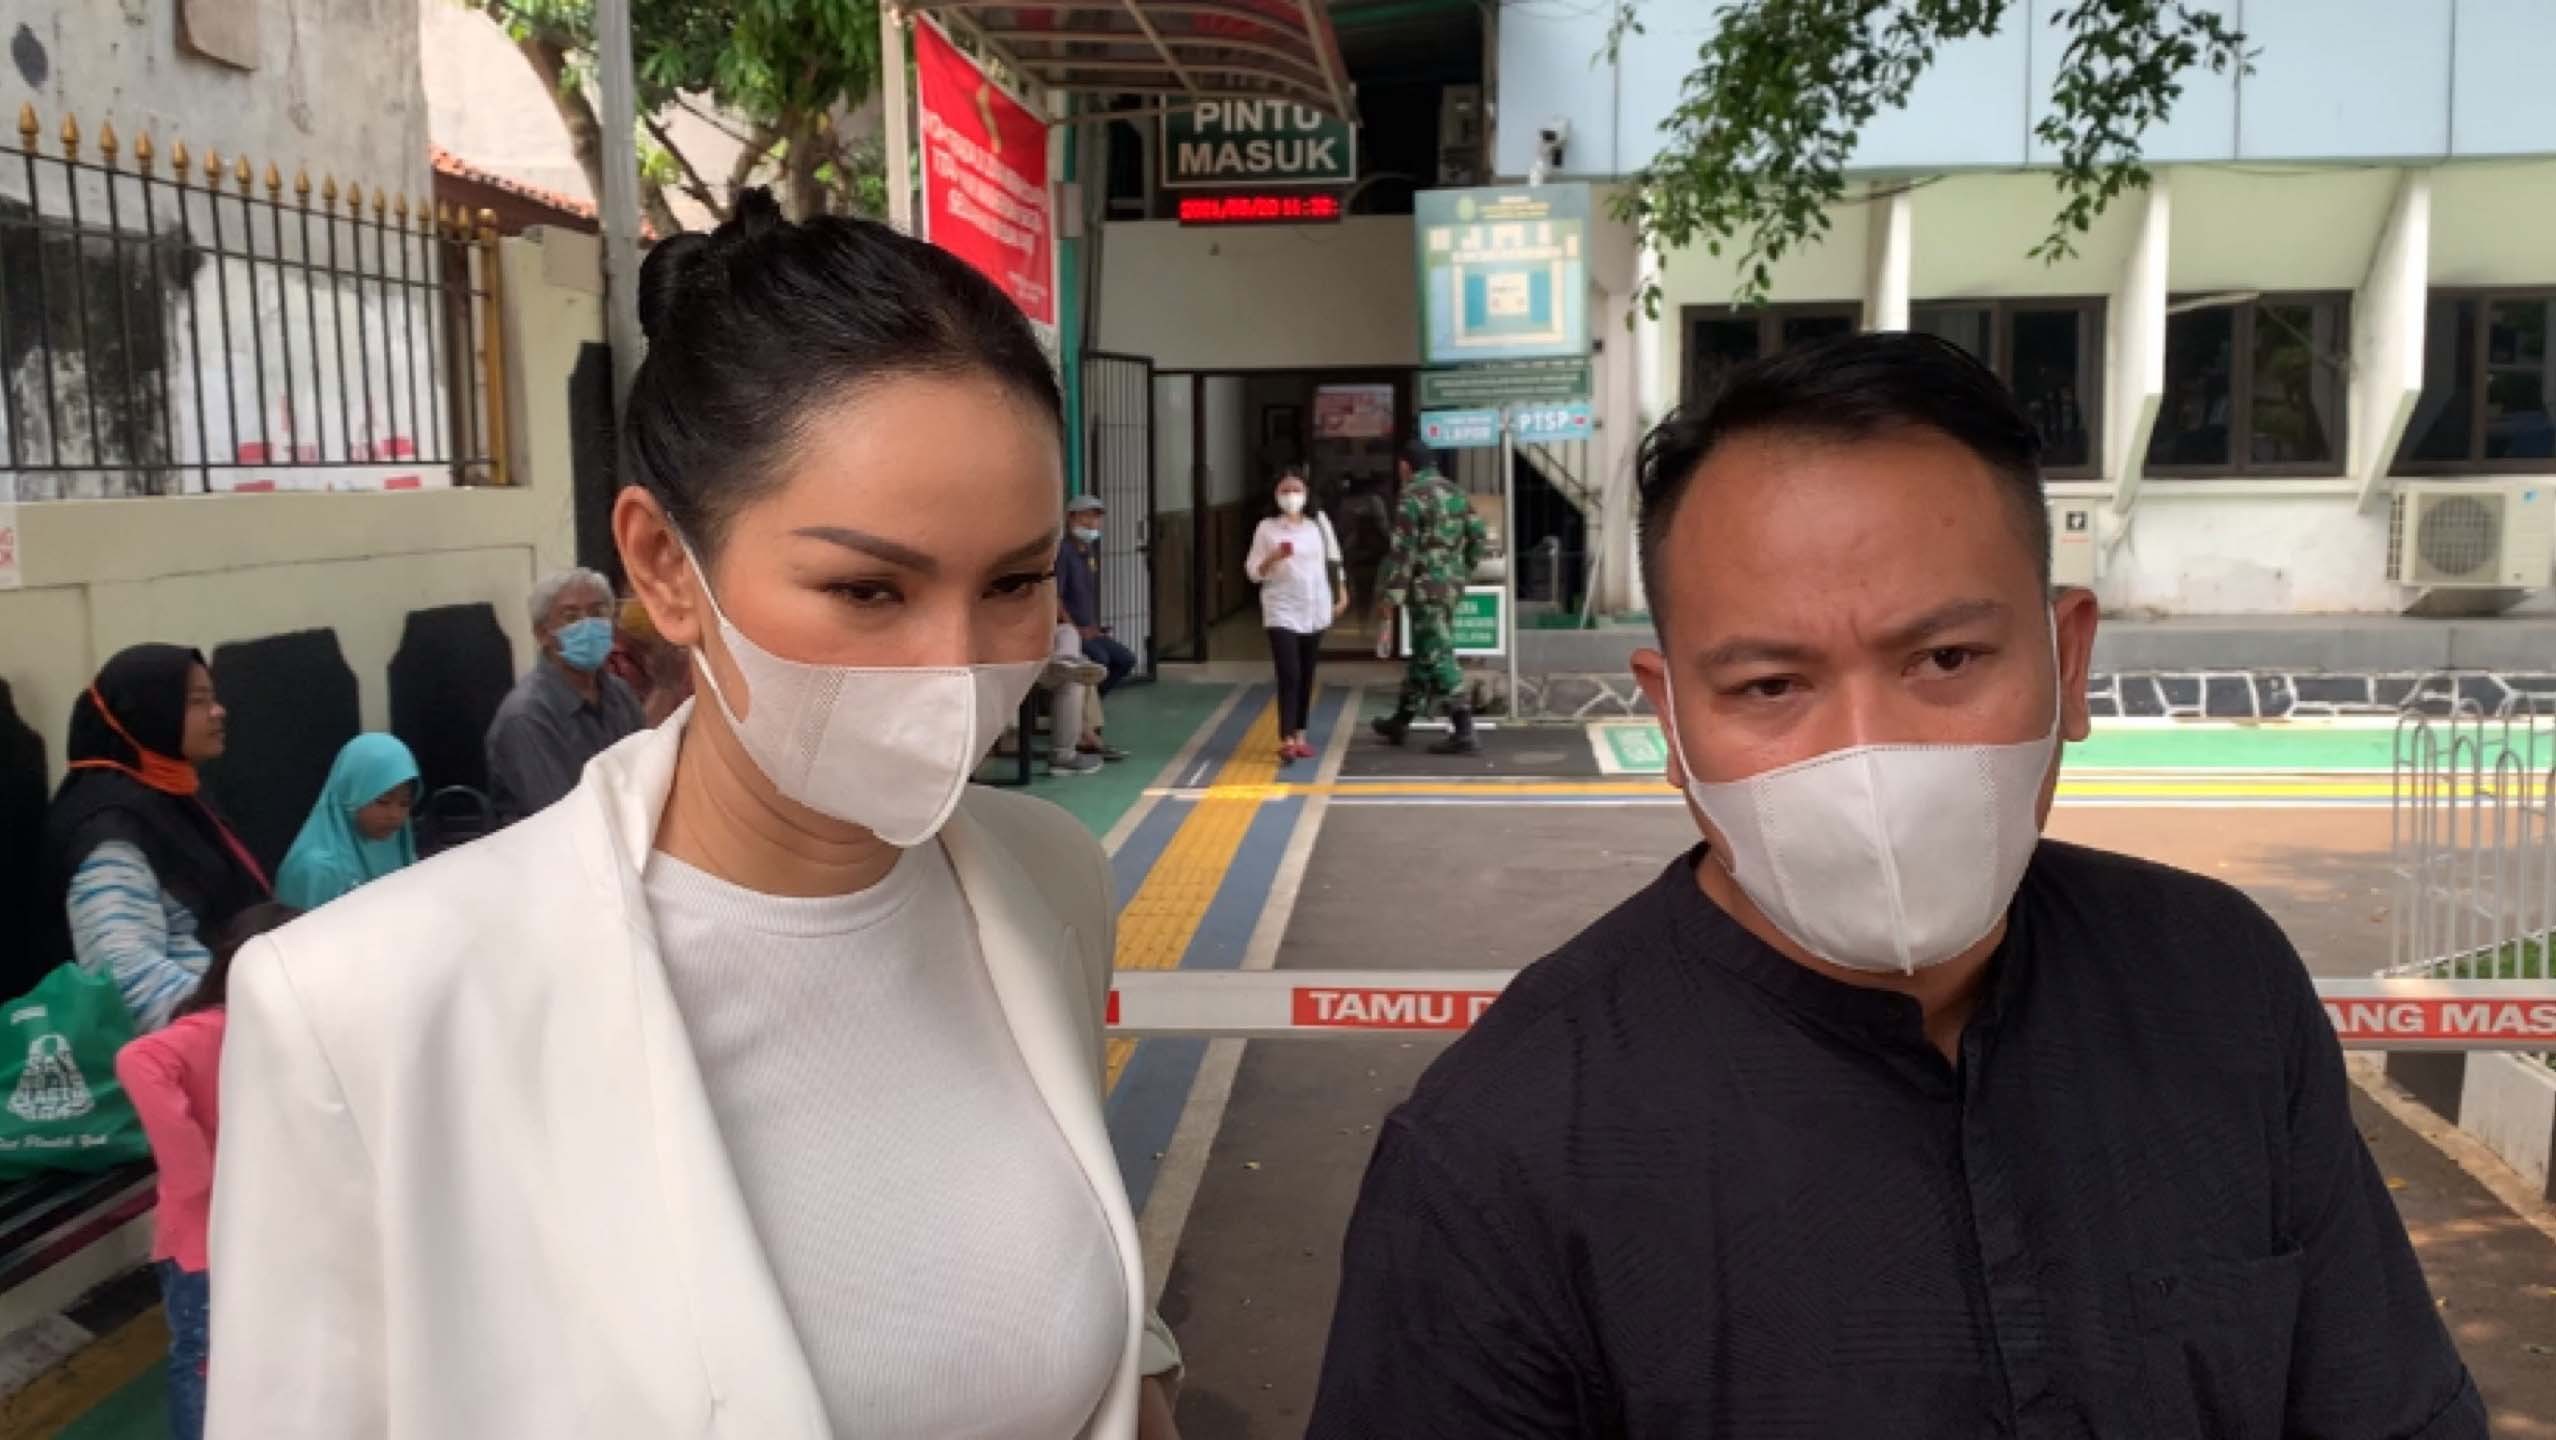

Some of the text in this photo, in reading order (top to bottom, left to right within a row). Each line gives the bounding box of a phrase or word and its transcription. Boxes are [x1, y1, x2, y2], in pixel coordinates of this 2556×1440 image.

[1193, 99, 1322, 133] PINTU
[1178, 138, 1338, 176] MASUK
[1309, 990, 1454, 1024] TAMU
